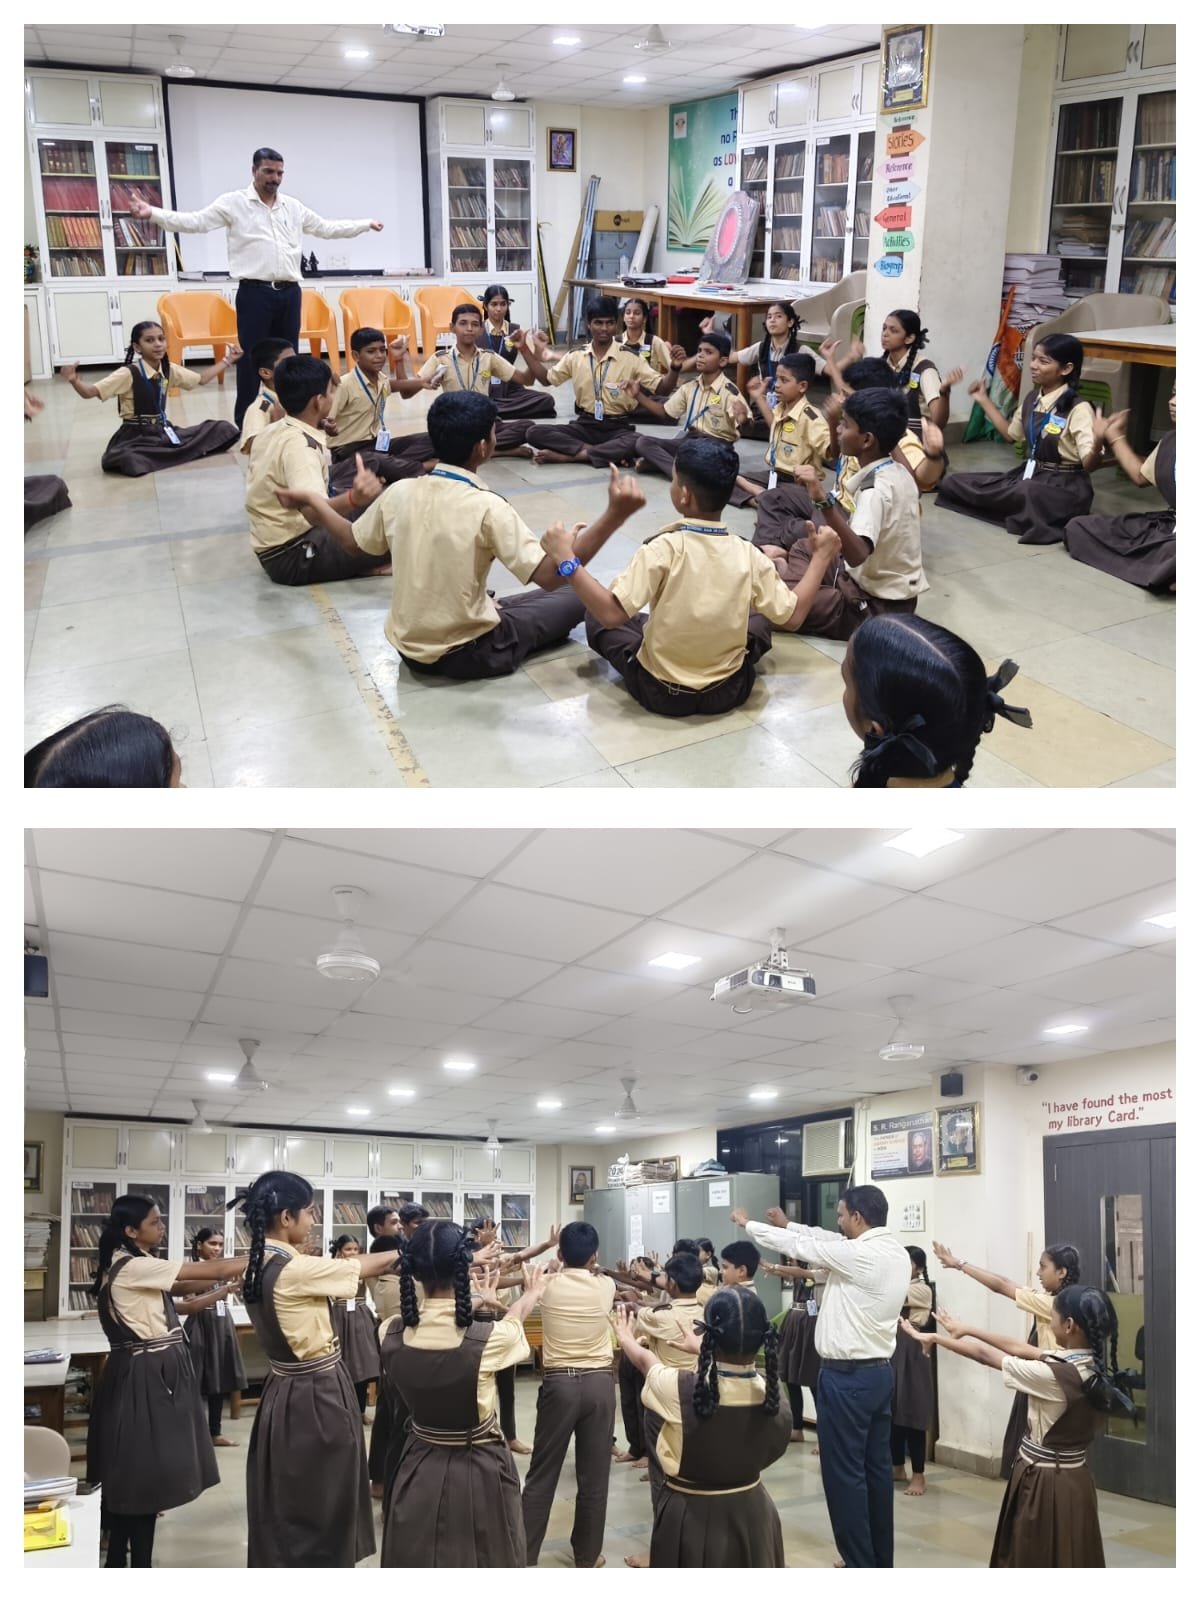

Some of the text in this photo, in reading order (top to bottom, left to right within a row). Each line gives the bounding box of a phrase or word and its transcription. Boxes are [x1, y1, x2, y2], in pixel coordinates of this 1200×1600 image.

[720, 134, 731, 144] no
[713, 157, 722, 166] as
[882, 212, 907, 223] General
[1053, 1101, 1079, 1113] have
[1082, 1095, 1114, 1109] found
[1118, 1092, 1138, 1105] the
[1142, 1088, 1173, 1102] most
[1048, 1120, 1063, 1131] my
[1067, 1115, 1103, 1127] library
